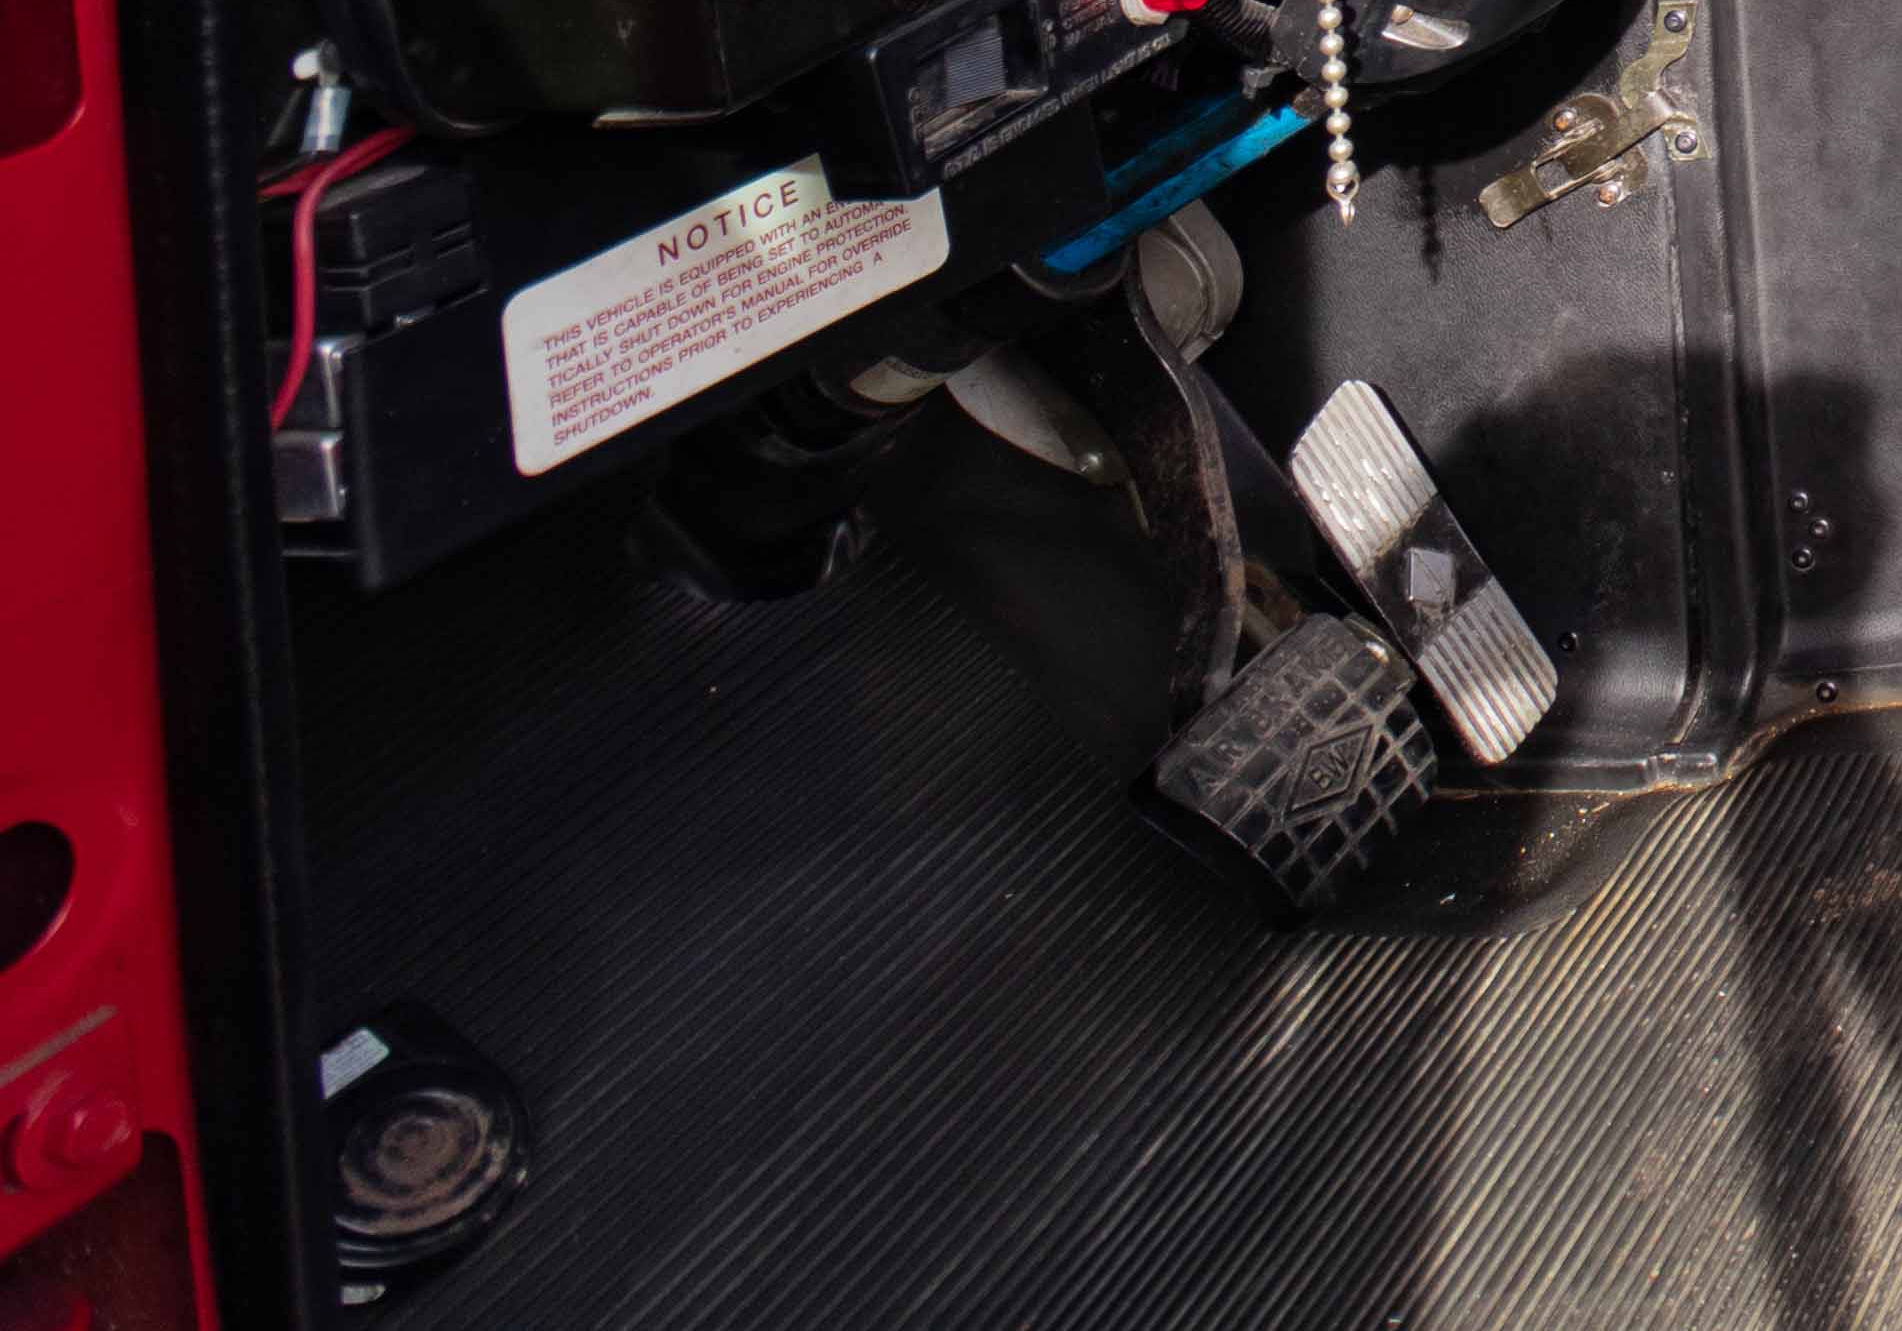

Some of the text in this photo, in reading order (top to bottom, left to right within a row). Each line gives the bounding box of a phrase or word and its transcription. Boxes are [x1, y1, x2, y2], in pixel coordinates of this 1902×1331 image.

[544, 205, 822, 354] THIS VEHICLE IS EQUIPPED WITH AN
[548, 345, 612, 391] TICALLY
[618, 322, 660, 356] SHUT
[667, 294, 716, 331] DOWN
[720, 276, 753, 304] FOR
[757, 247, 811, 286] ENGINE
[815, 198, 909, 257] PROTECTION.
[657, 176, 800, 269] NOTICE
[546, 339, 586, 372] THAT
[592, 328, 608, 349] IS
[613, 289, 687, 339] CAPABLE
[691, 278, 712, 300] OF
[717, 252, 763, 288] BEING
[767, 236, 796, 263] SET
[800, 224, 820, 246] TO
[550, 215, 912, 409] REFER TO OPERATOR'S MANUAL FOR OVERRIDE
[551, 248, 883, 427] INSTRUCTIONS PRIOR TO EXPERIENCING A
[554, 382, 654, 447] SHUTDOWN.
[1312, 739, 1357, 790] BW
